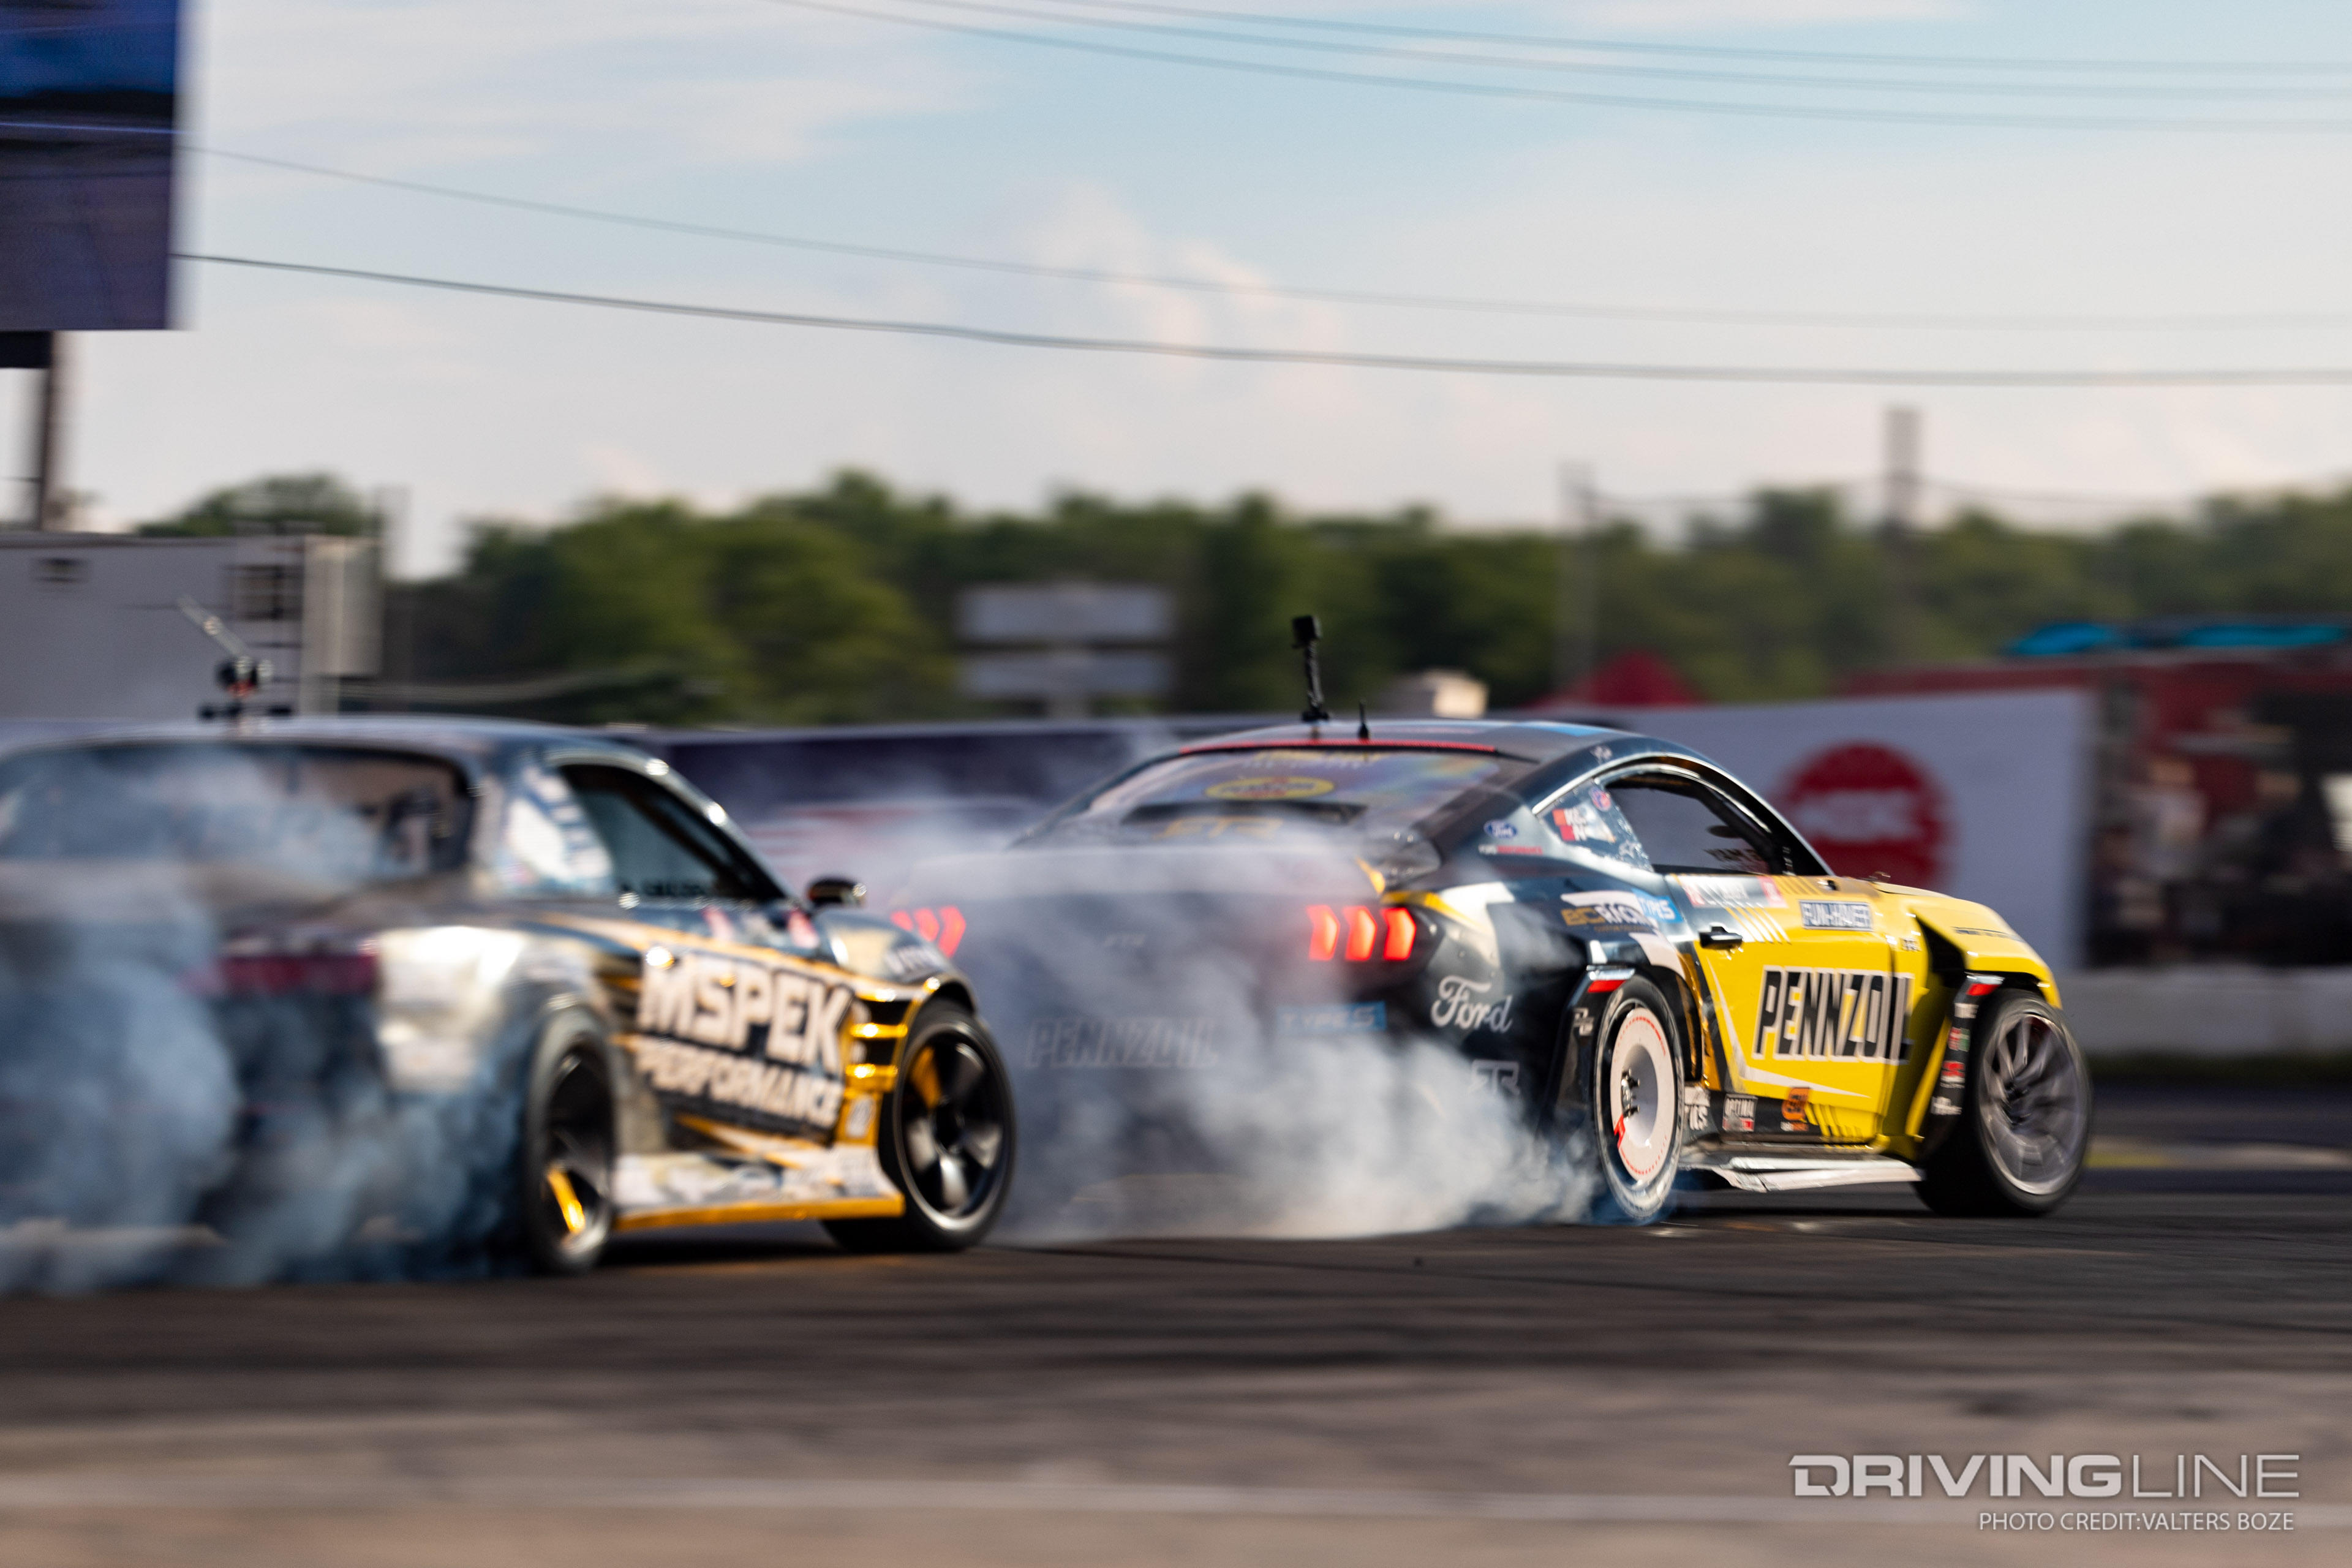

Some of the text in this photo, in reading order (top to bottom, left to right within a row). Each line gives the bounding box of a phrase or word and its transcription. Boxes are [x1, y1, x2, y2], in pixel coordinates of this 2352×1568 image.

[635, 952, 853, 1073] MSPEK
[1430, 975, 1513, 1033] Ford
[1751, 964, 1916, 1065] PENNZOIL
[635, 1039, 845, 1128] PERFORMANCE
